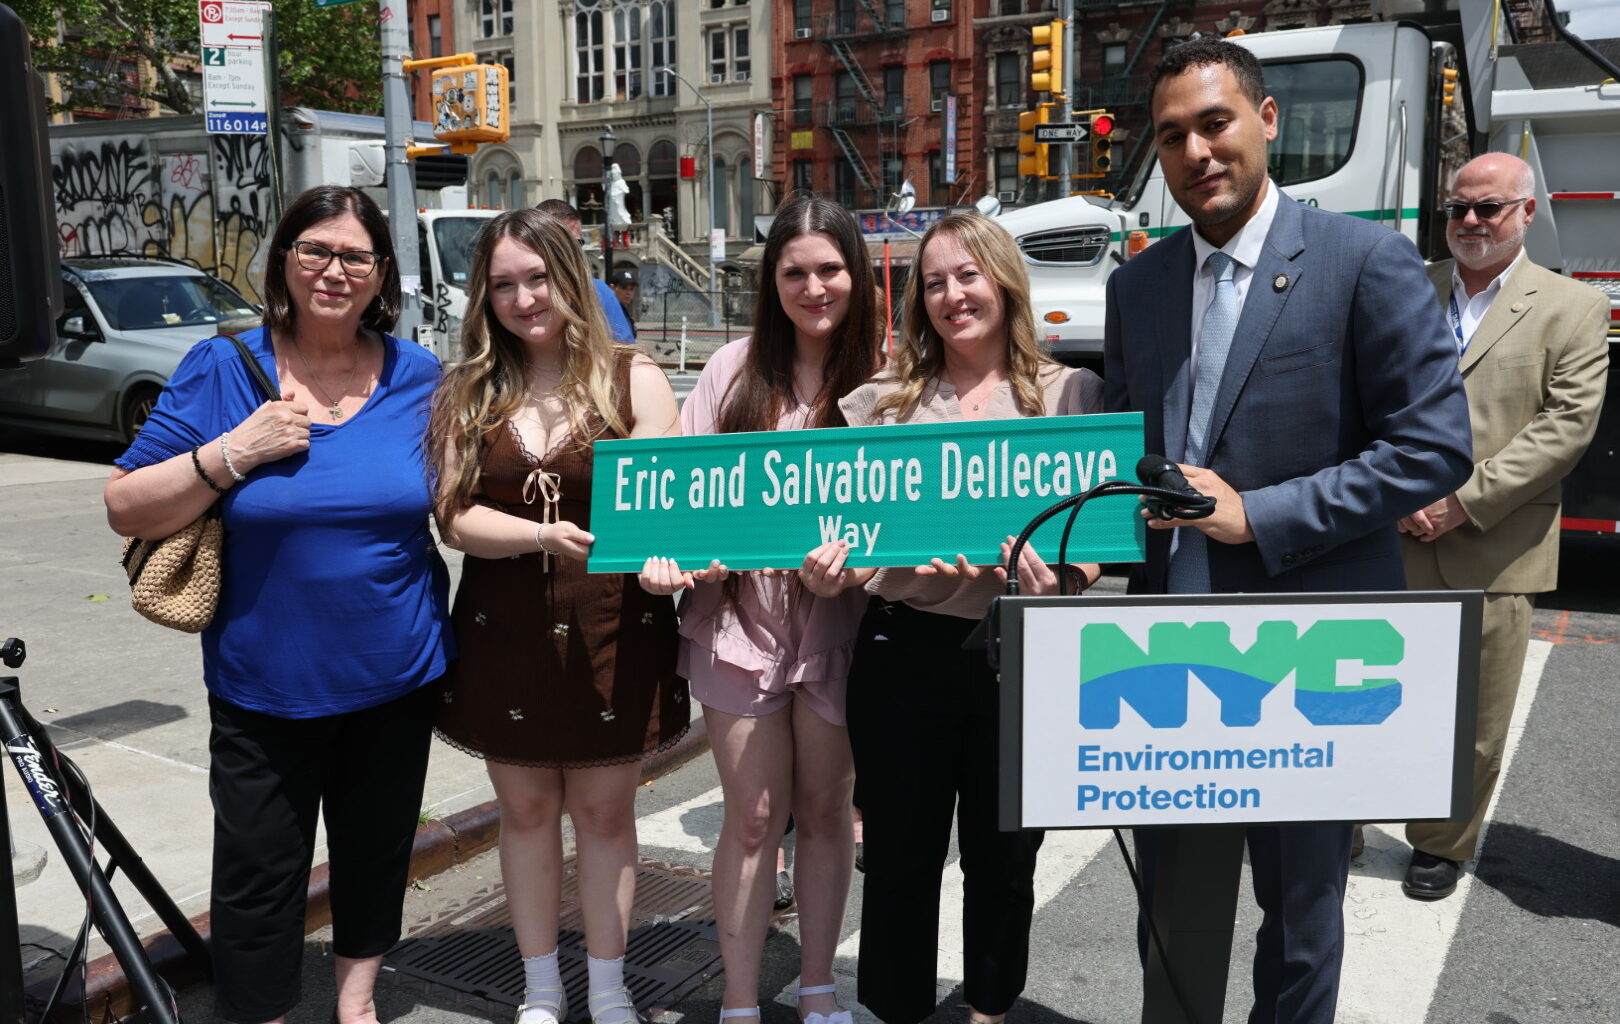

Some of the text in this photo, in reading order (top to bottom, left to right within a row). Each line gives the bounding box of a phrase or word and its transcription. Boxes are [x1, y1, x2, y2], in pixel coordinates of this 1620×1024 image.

[209, 48, 220, 65] 2
[1042, 129, 1082, 137] ONE WAY
[615, 439, 1117, 511] Eric and Salvatore Dellecave
[818, 515, 881, 556] Way
[1079, 619, 1405, 730] NYC
[7, 735, 61, 808] Fender
[1078, 741, 1334, 772] Environmental
[1077, 782, 1261, 811] Protection
